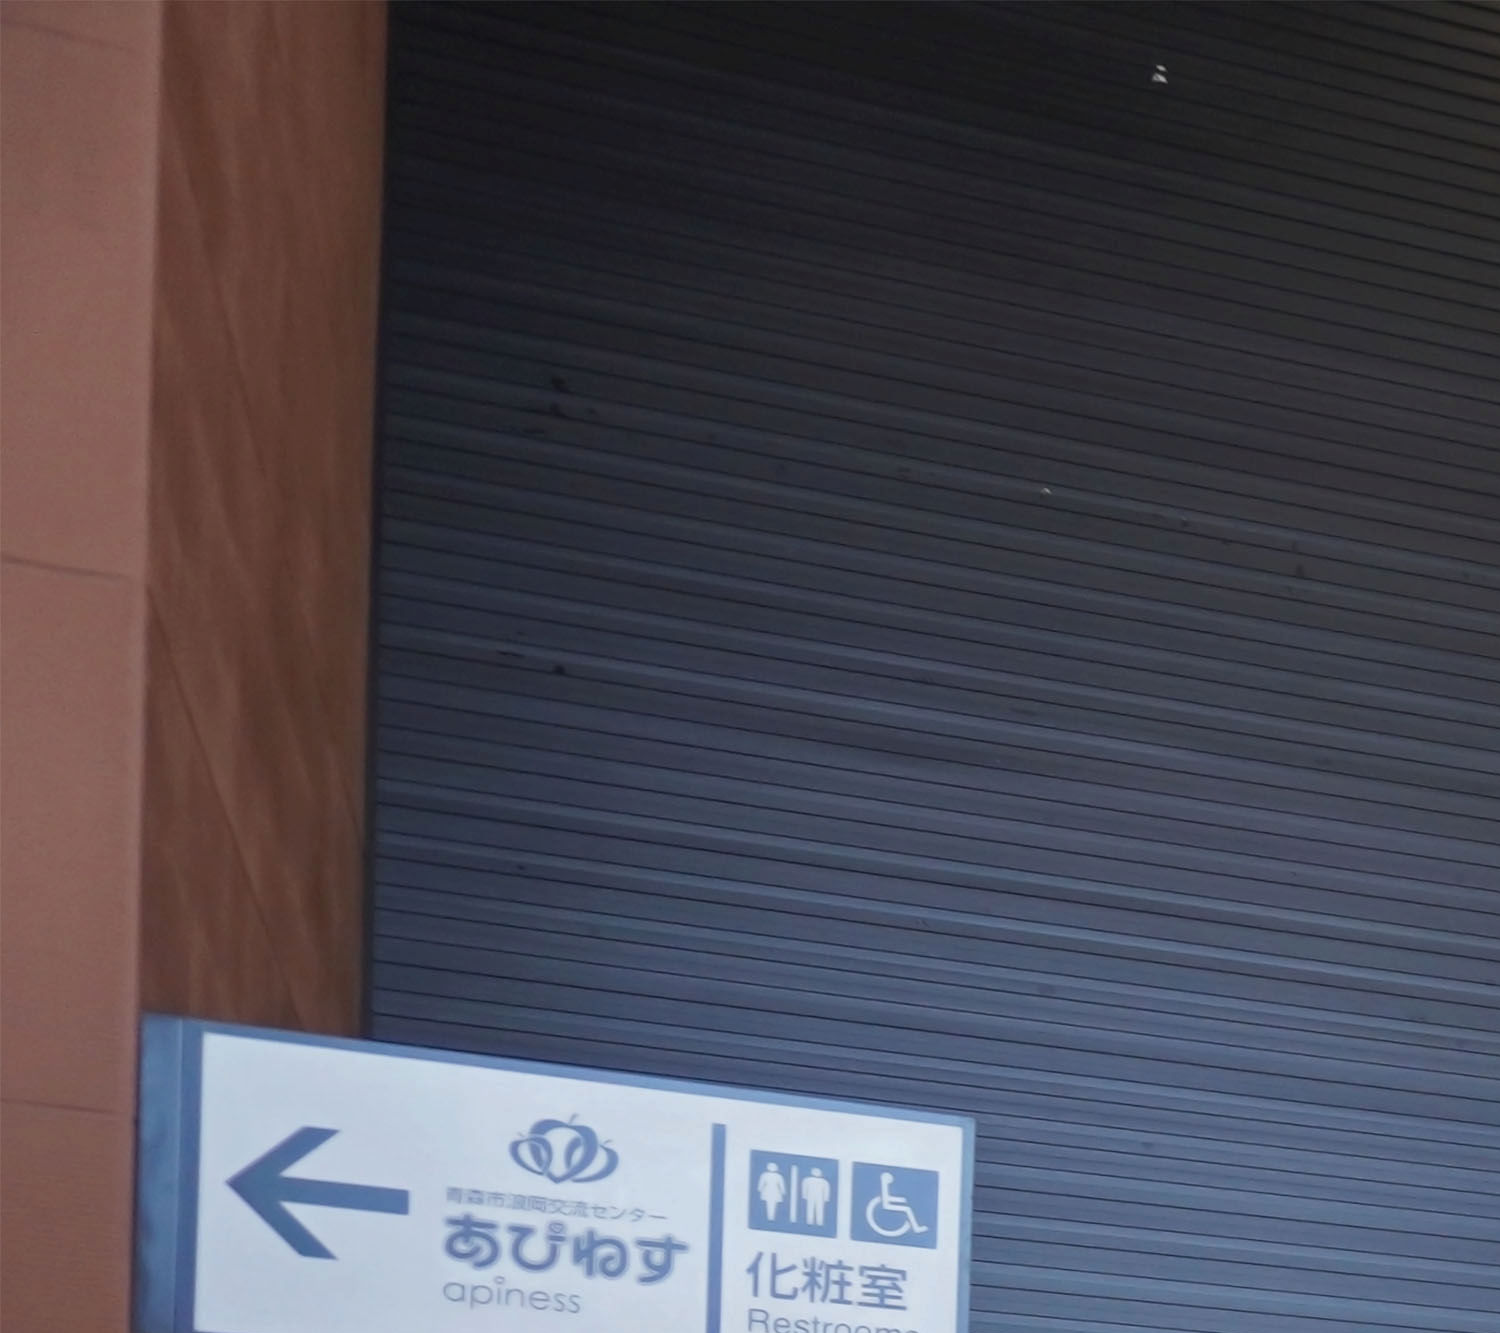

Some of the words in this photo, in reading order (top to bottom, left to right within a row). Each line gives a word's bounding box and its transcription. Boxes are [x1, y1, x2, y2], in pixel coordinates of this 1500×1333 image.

[445, 1213, 690, 1284] あぴねす
[443, 1276, 582, 1313] apiness
[746, 1250, 909, 1312] 化粧室
